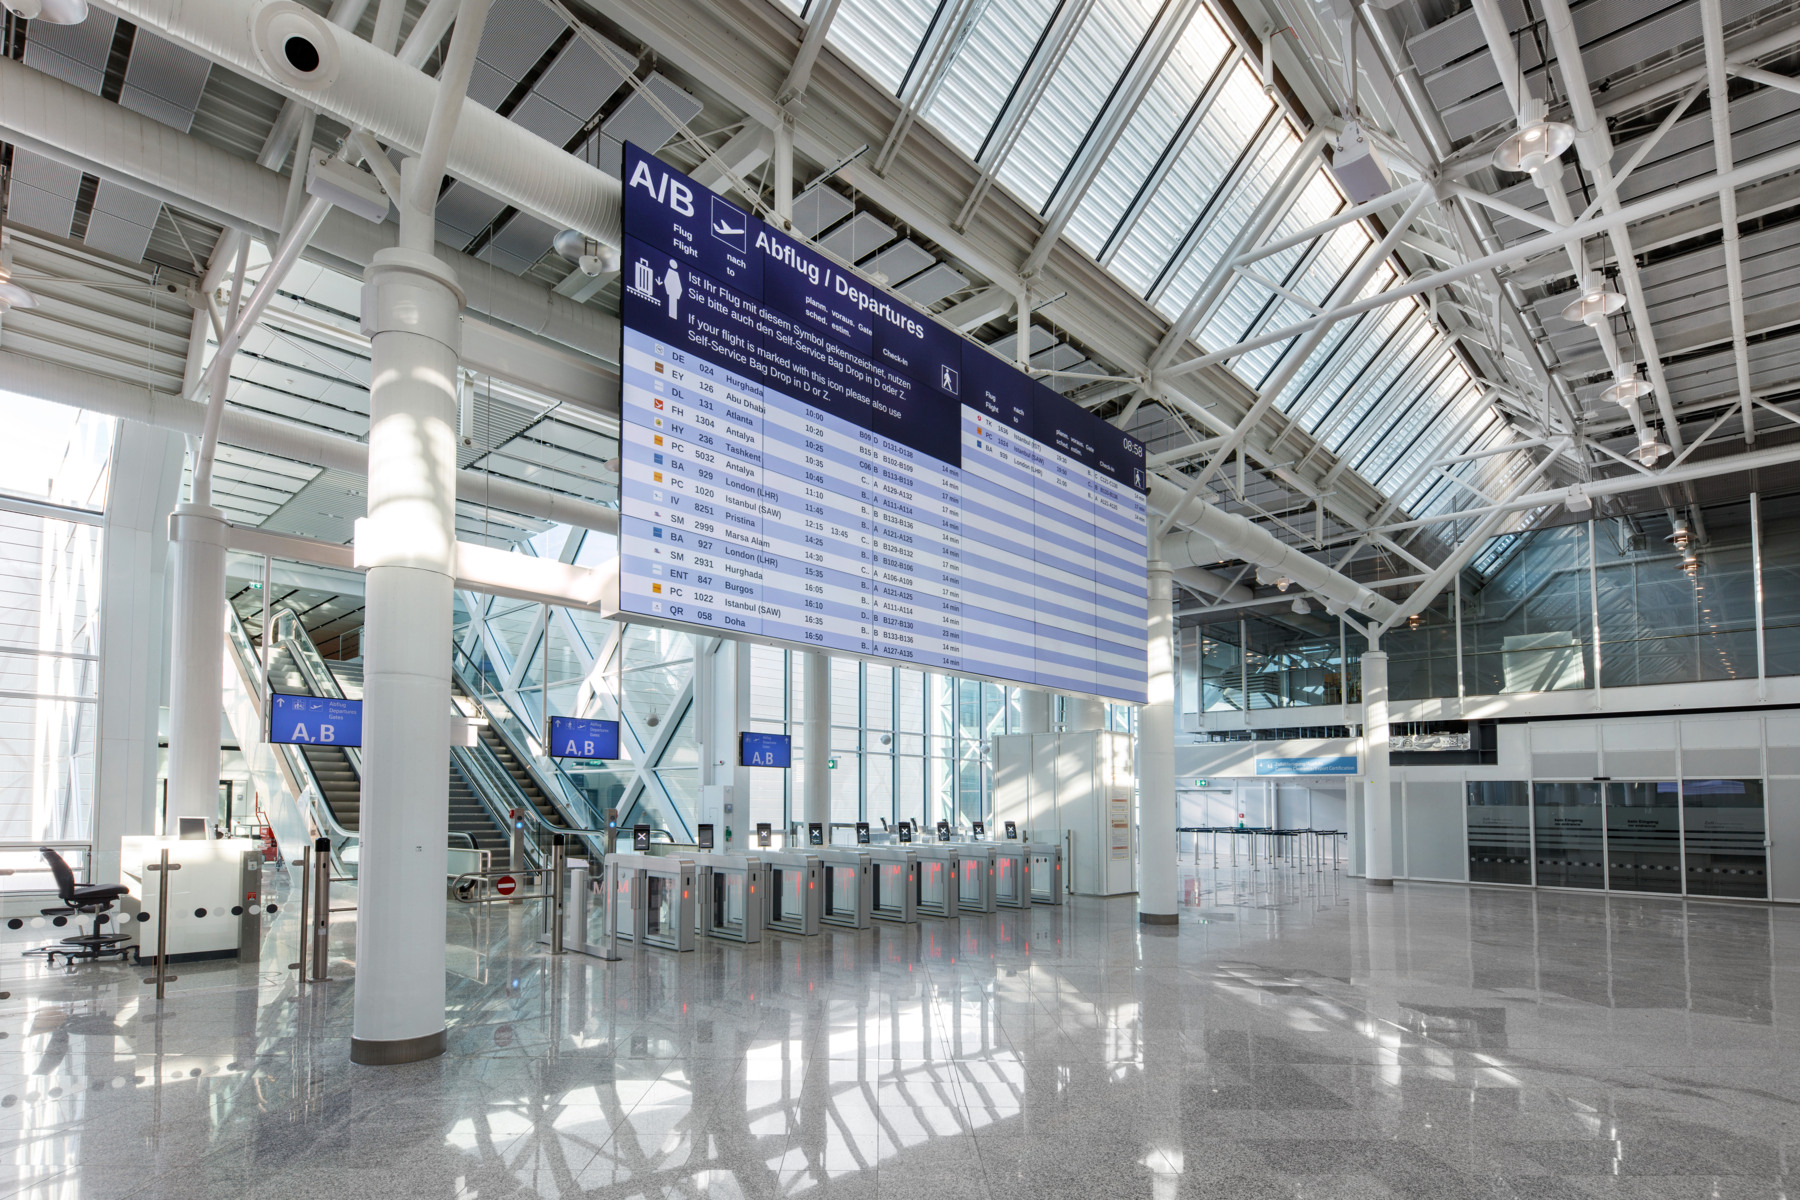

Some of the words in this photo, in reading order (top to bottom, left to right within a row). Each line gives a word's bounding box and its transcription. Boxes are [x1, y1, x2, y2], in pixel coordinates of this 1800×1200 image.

[629, 160, 694, 217] A/B
[673, 223, 692, 242] Flug
[673, 238, 698, 258] Flight
[726, 267, 735, 277] to
[727, 254, 746, 269] nach
[755, 231, 819, 285] Abflug
[824, 269, 830, 287] /
[836, 275, 924, 339] Departures
[689, 272, 701, 290] Ist
[704, 279, 717, 294] Ihr
[719, 287, 740, 308] Flug
[743, 301, 757, 314] mit
[759, 308, 791, 331] diesem
[793, 324, 824, 347] Symbol
[825, 342, 886, 379] gekennzeichnet,
[888, 373, 911, 390] nutzen
[805, 296, 828, 313] planm.
[832, 310, 855, 327] voraus.
[858, 323, 872, 336] Gate
[806, 309, 828, 325] sched.
[831, 323, 851, 337] estim.
[688, 288, 705, 304] Sie
[708, 296, 728, 315] bitte
[731, 310, 754, 328] auch
[756, 322, 774, 337] den
[776, 330, 826, 362] Self-Service
[828, 355, 844, 372] Bag
[846, 364, 864, 381] Drop
[865, 373, 872, 384] in
[874, 378, 880, 388] D
[882, 383, 898, 396] oder
[899, 390, 905, 400] Z.
[688, 330, 747, 364] Self-Service
[749, 357, 768, 376] Bag
[770, 366, 792, 385] Drop
[794, 376, 801, 388] in
[803, 381, 811, 392] D
[812, 387, 821, 396] or
[822, 390, 831, 401] Z.
[688, 313, 695, 325] If
[697, 319, 719, 336] your
[722, 329, 745, 348] flight
[747, 340, 755, 352] is
[757, 347, 790, 369] marked
[792, 364, 809, 377] with
[811, 371, 826, 385] this
[827, 378, 844, 393] icon
[846, 388, 870, 405] please
[872, 400, 887, 412] also
[888, 408, 902, 419] use
[672, 352, 685, 364] DE
[699, 363, 714, 376] 024
[726, 375, 763, 396] Hurghada
[806, 408, 824, 422] 10:00
[859, 430, 872, 441] B09
[672, 370, 684, 381] EY
[700, 381, 714, 393] 126
[726, 392, 742, 405] Abu
[743, 399, 766, 414] Dhabi
[806, 424, 824, 437] 10:20
[859, 446, 872, 456] B15
[671, 424, 684, 434] HY
[698, 433, 714, 445] 236
[725, 443, 761, 462] Tashkent
[806, 471, 824, 484] 10:45
[672, 388, 684, 399] DL
[699, 399, 714, 411] 131
[726, 409, 753, 426] Atlanta
[806, 440, 824, 453] 10:25
[859, 460, 872, 471] C06
[672, 405, 684, 417] FH
[696, 414, 715, 428] 1304
[726, 426, 755, 443] Antalya
[806, 456, 824, 468] 10:35
[1123, 438, 1142, 457] 08:58
[671, 442, 684, 453] PC
[695, 450, 715, 463] 5032
[726, 461, 755, 477] Antalya
[806, 487, 824, 500] 11:10
[671, 460, 684, 471] BA
[698, 469, 713, 480] 929
[725, 477, 755, 494] London
[757, 488, 779, 503] (LHR)
[805, 503, 824, 515] 11:45
[671, 478, 684, 489] PC
[695, 485, 714, 498] 1020
[726, 495, 757, 511] Istanbul
[758, 505, 782, 520] (SAW)
[805, 519, 824, 531] 12:15
[831, 527, 848, 538] 13:45
[671, 496, 680, 505] IV
[694, 503, 714, 515] 8251
[725, 512, 755, 527] Pristina
[805, 535, 824, 547] 14:25
[670, 514, 684, 525] SM
[694, 520, 714, 533] 2999
[725, 529, 749, 542] Marsa
[751, 536, 770, 548] Alam
[805, 551, 824, 562] 14:30
[670, 532, 684, 543] BA
[698, 539, 713, 550] 927
[725, 546, 755, 561] London
[756, 554, 778, 568] (LHR)
[805, 567, 824, 578] 15:35
[670, 551, 684, 561] SM
[694, 556, 714, 568] 2931
[725, 564, 762, 580] Hurghada
[805, 583, 824, 594] 16:05
[670, 569, 689, 580] ENT
[697, 575, 712, 585] 847
[725, 581, 754, 595] Burgos
[805, 599, 823, 610] 16:10
[670, 587, 683, 597] PC
[694, 592, 714, 603] 1022
[725, 598, 756, 612] Istanbul
[758, 605, 781, 618] (SAW)
[805, 615, 824, 626] 16:35
[670, 606, 684, 616] QR
[697, 611, 712, 621] 058
[724, 616, 746, 627] Doha
[805, 631, 823, 641] 16:50
